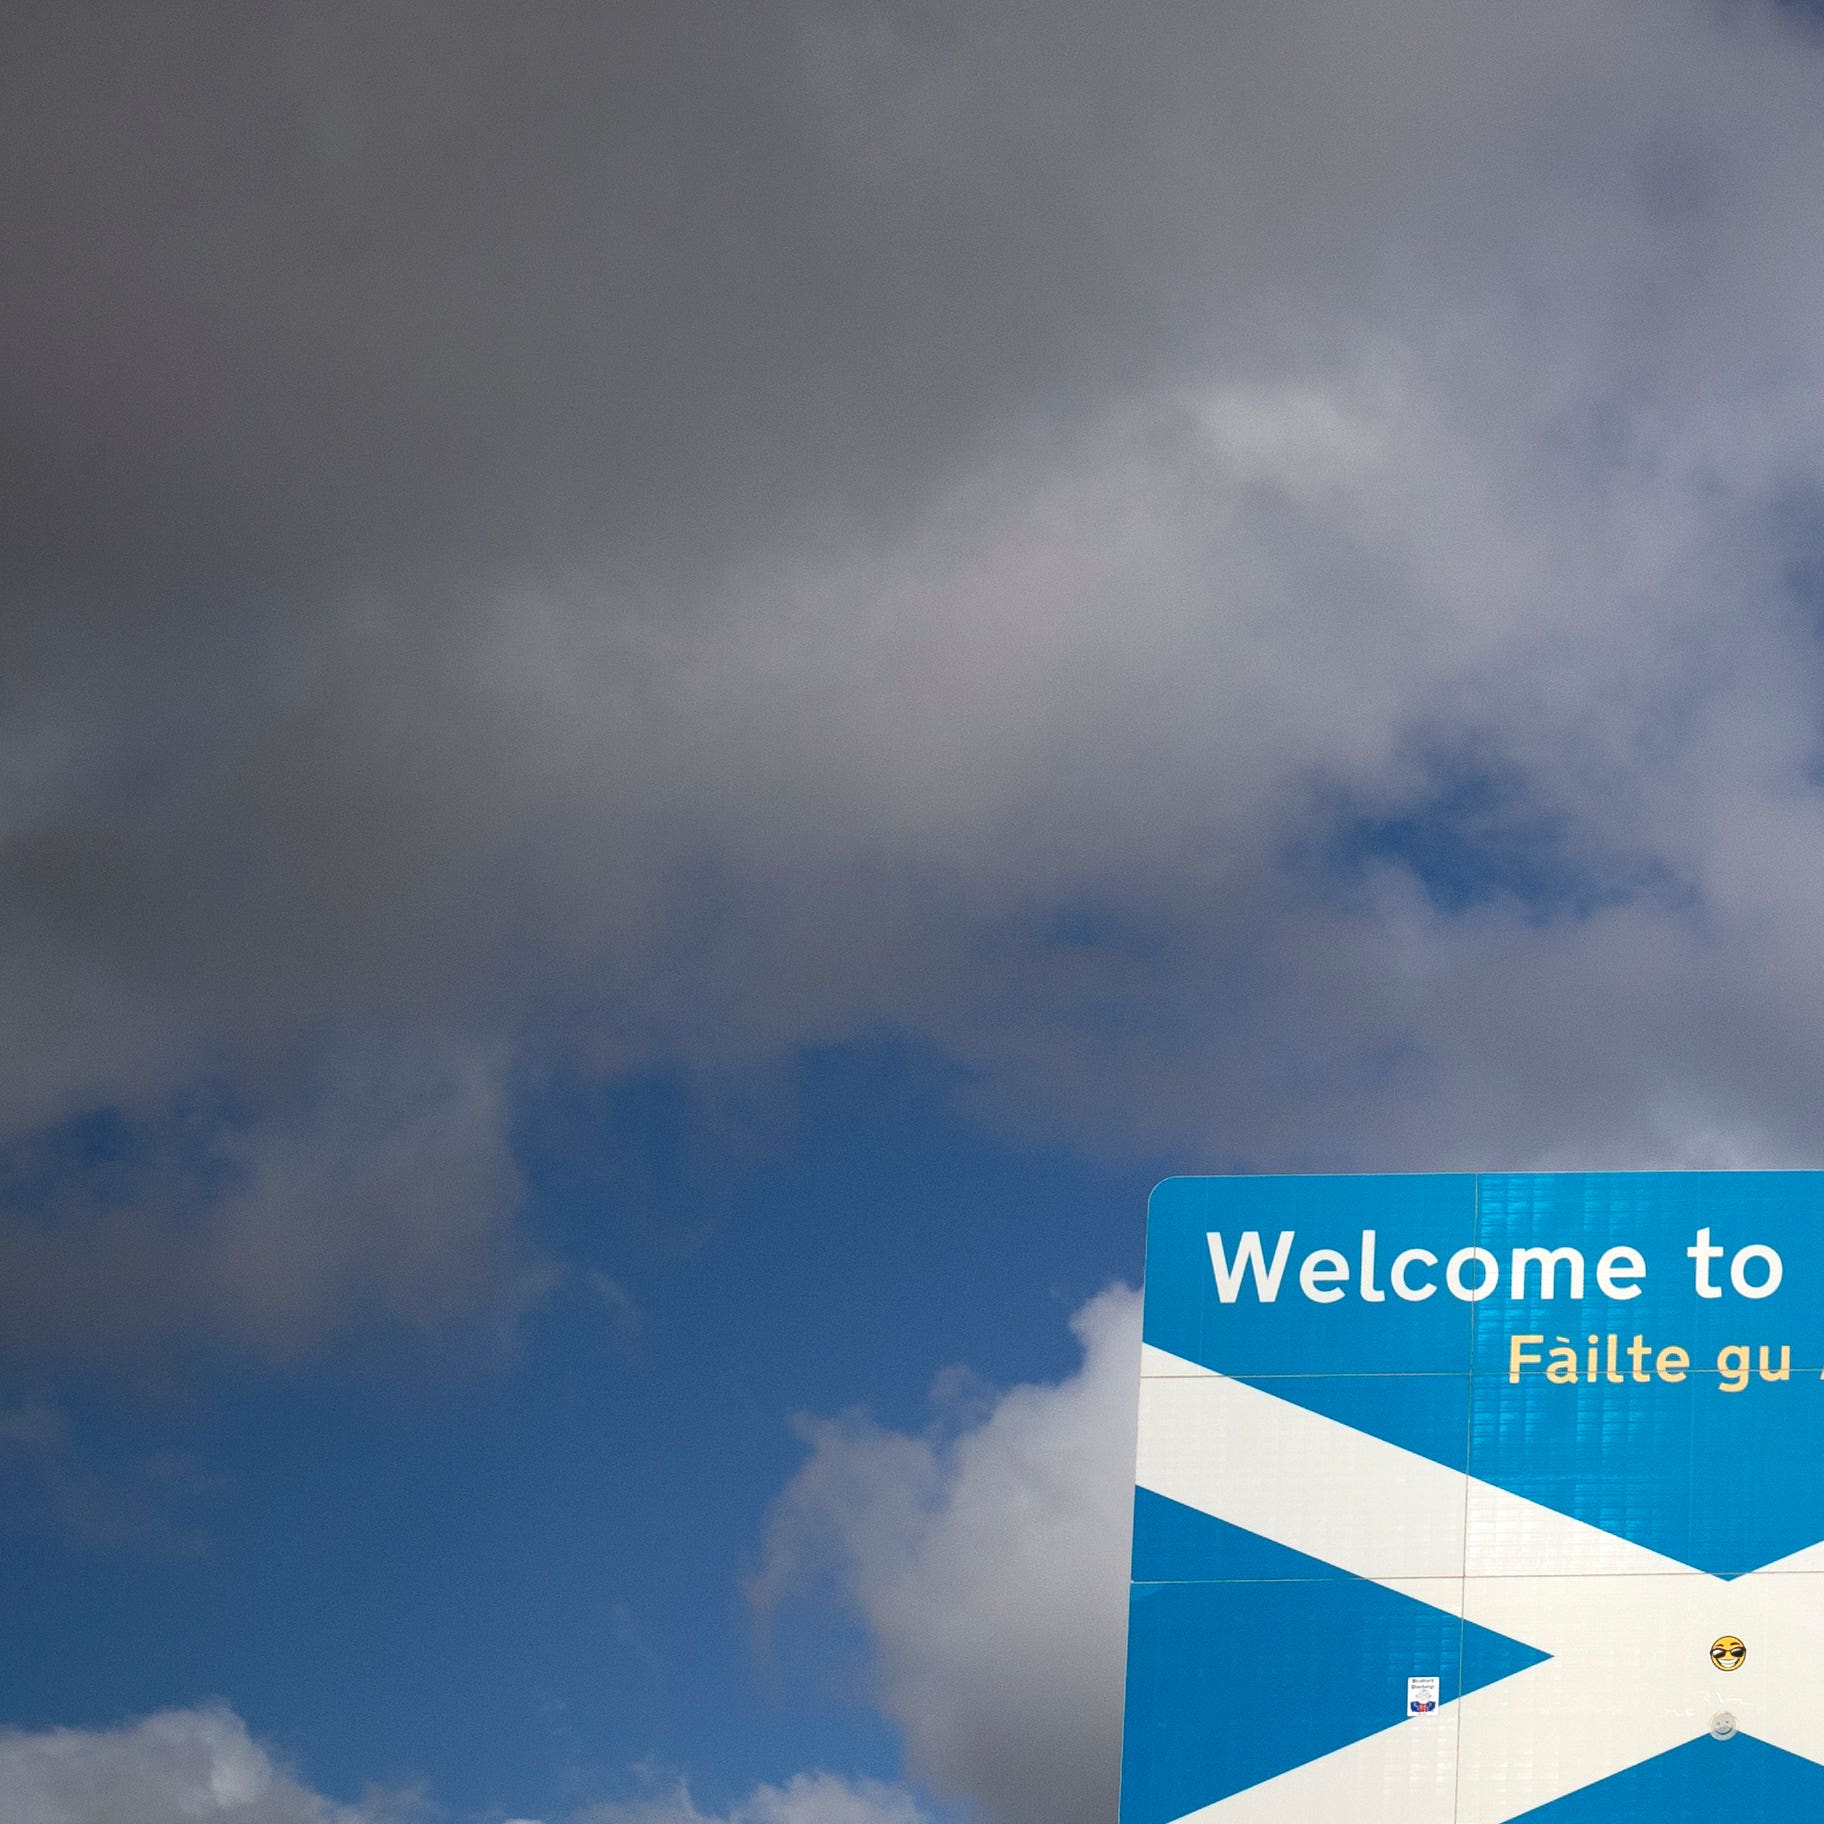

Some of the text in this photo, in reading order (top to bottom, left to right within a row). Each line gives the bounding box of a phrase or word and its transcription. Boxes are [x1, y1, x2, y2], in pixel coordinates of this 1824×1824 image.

[1206, 1229, 1647, 1304] Welcome
[1687, 1226, 1783, 1300] to
[1508, 1332, 1690, 1384] Fàilte
[1717, 1344, 1790, 1393] gu
